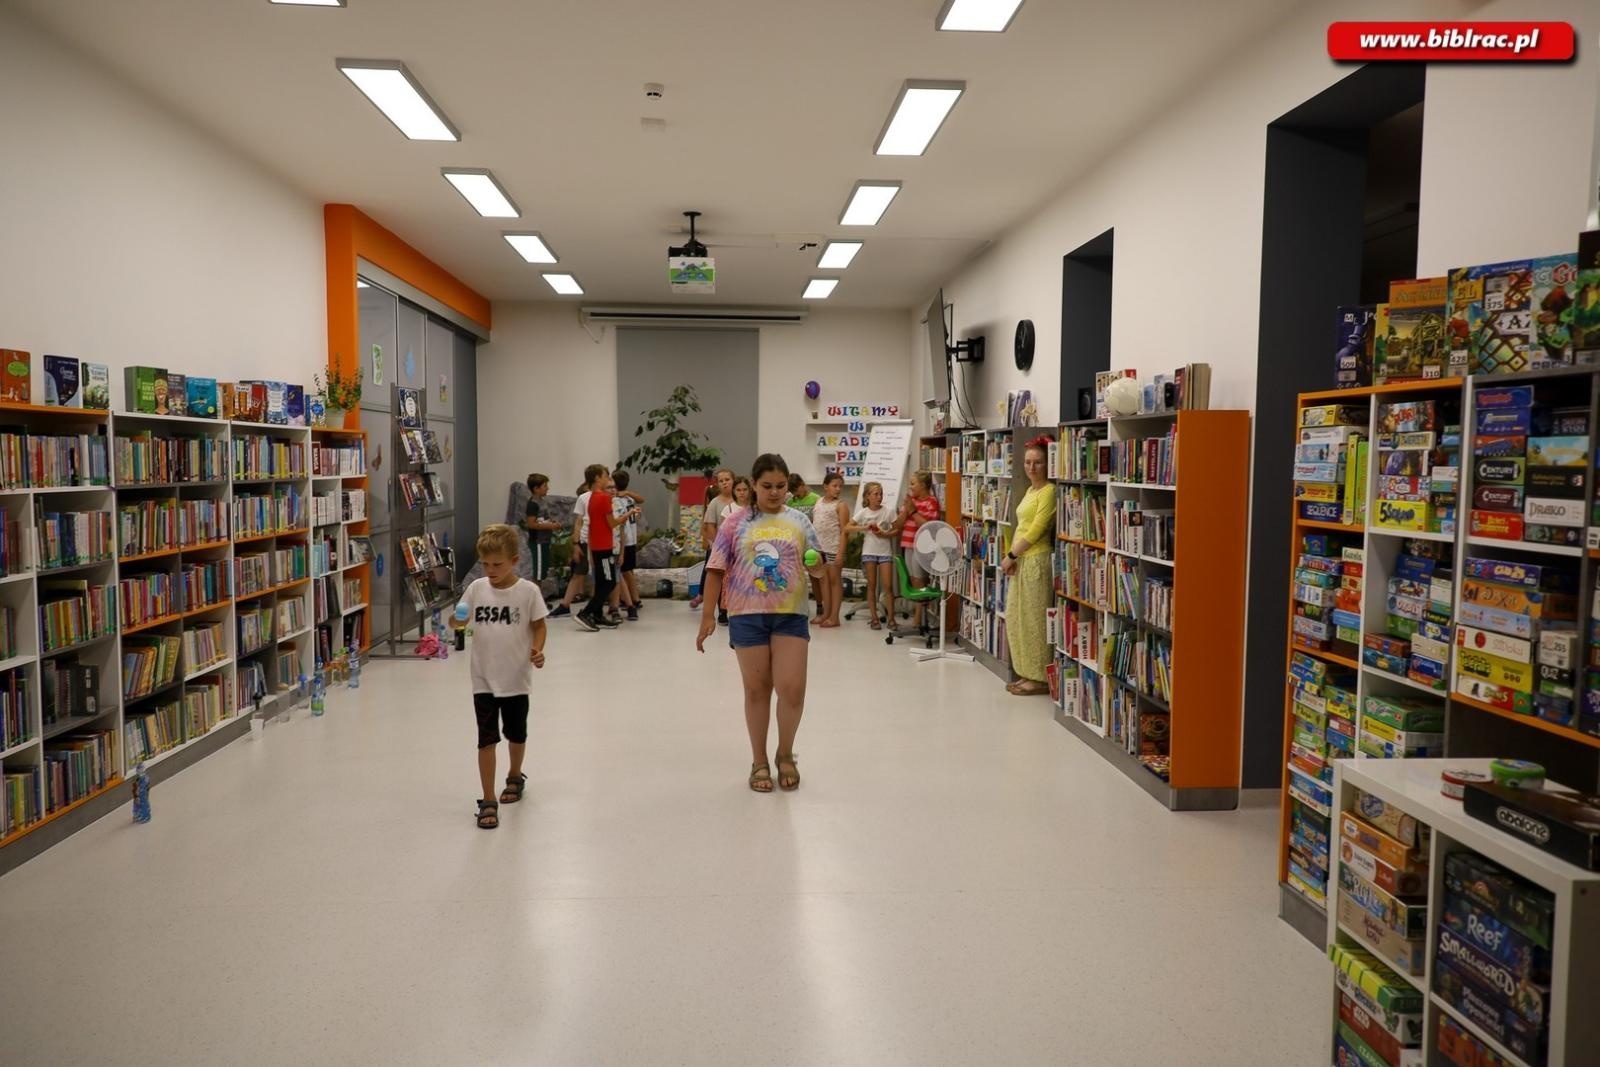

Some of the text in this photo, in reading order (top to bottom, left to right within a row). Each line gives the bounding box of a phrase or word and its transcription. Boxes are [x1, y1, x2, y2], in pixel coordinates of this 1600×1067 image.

[1424, 369, 1441, 378] 310
[828, 406, 898, 416] WITAMY
[849, 422, 864, 432] W
[1480, 464, 1514, 477] CENTURY
[475, 606, 511, 625] ESSA
[1498, 809, 1547, 838] abalone
